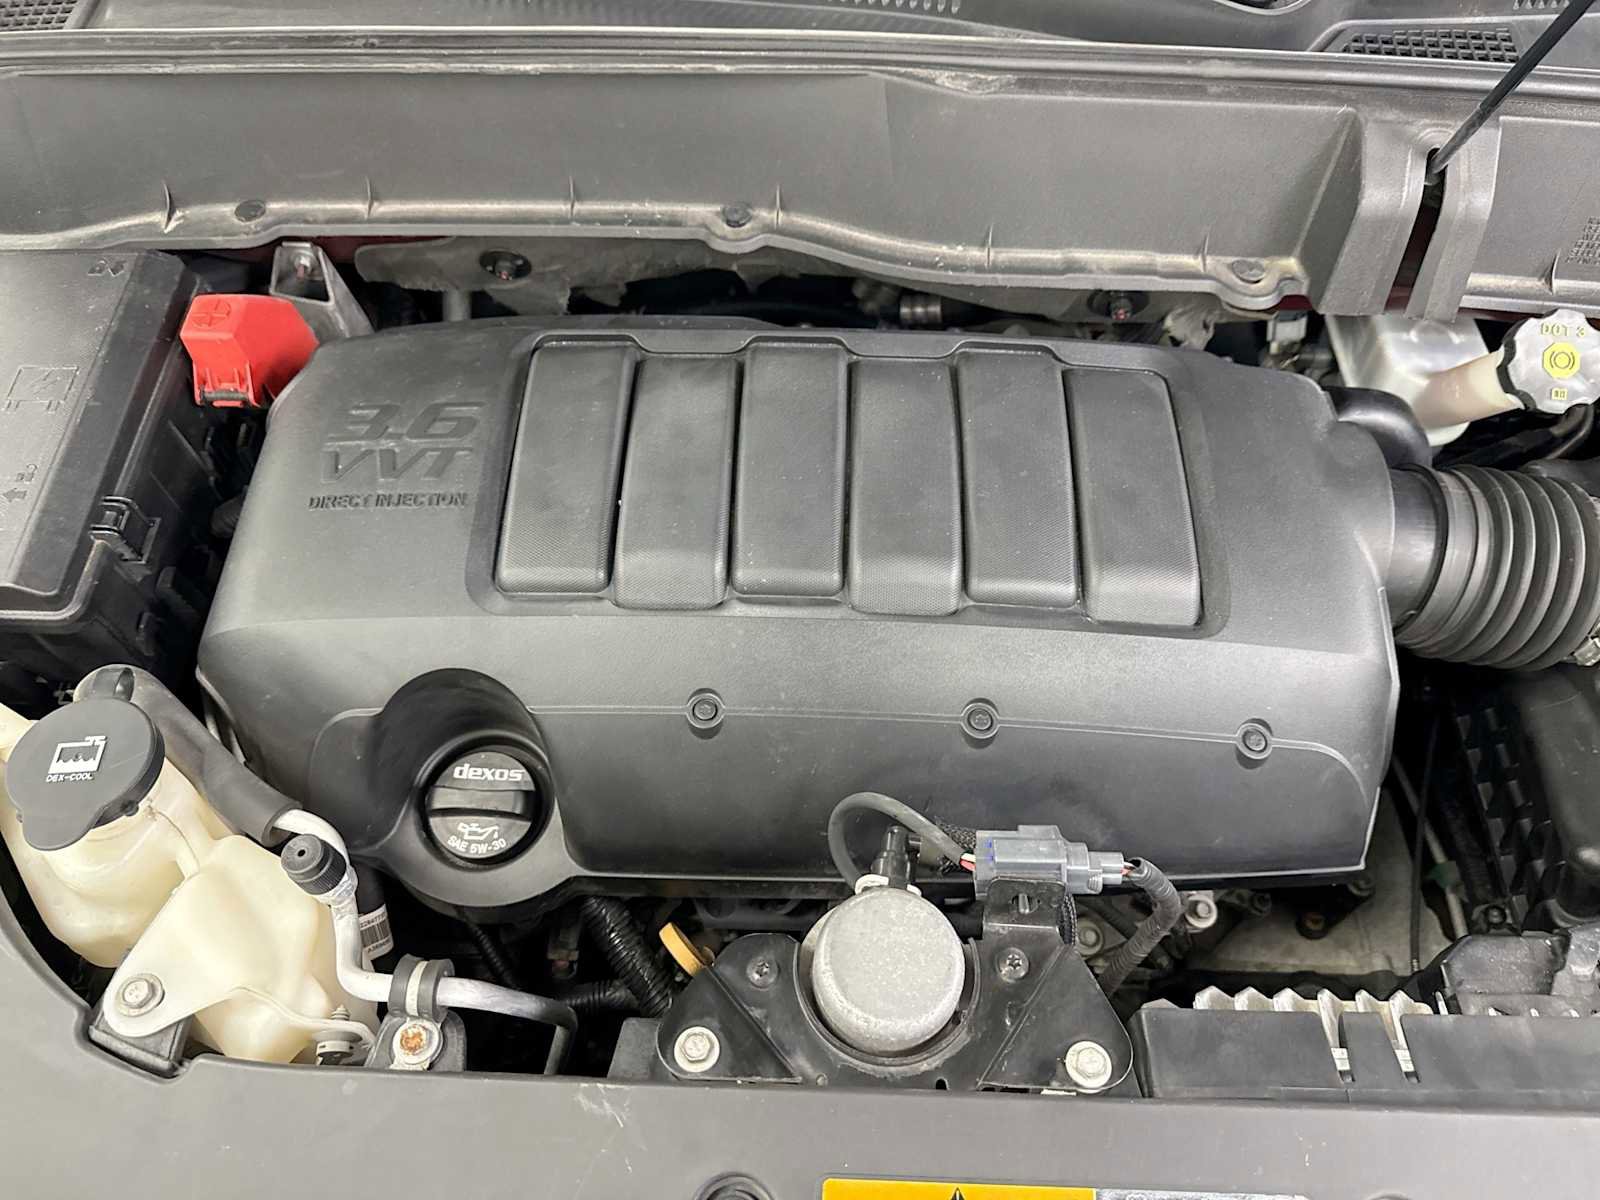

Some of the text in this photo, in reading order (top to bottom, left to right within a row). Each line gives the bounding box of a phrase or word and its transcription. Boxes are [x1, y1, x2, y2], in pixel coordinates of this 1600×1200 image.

[325, 401, 488, 445] 3.6
[320, 447, 474, 484] VVT
[308, 492, 468, 510] DIRECT INJECTION
[45, 773, 94, 782] DEX-COOL
[453, 763, 525, 781] dexos
[447, 835, 507, 854] SAE 5W-30
